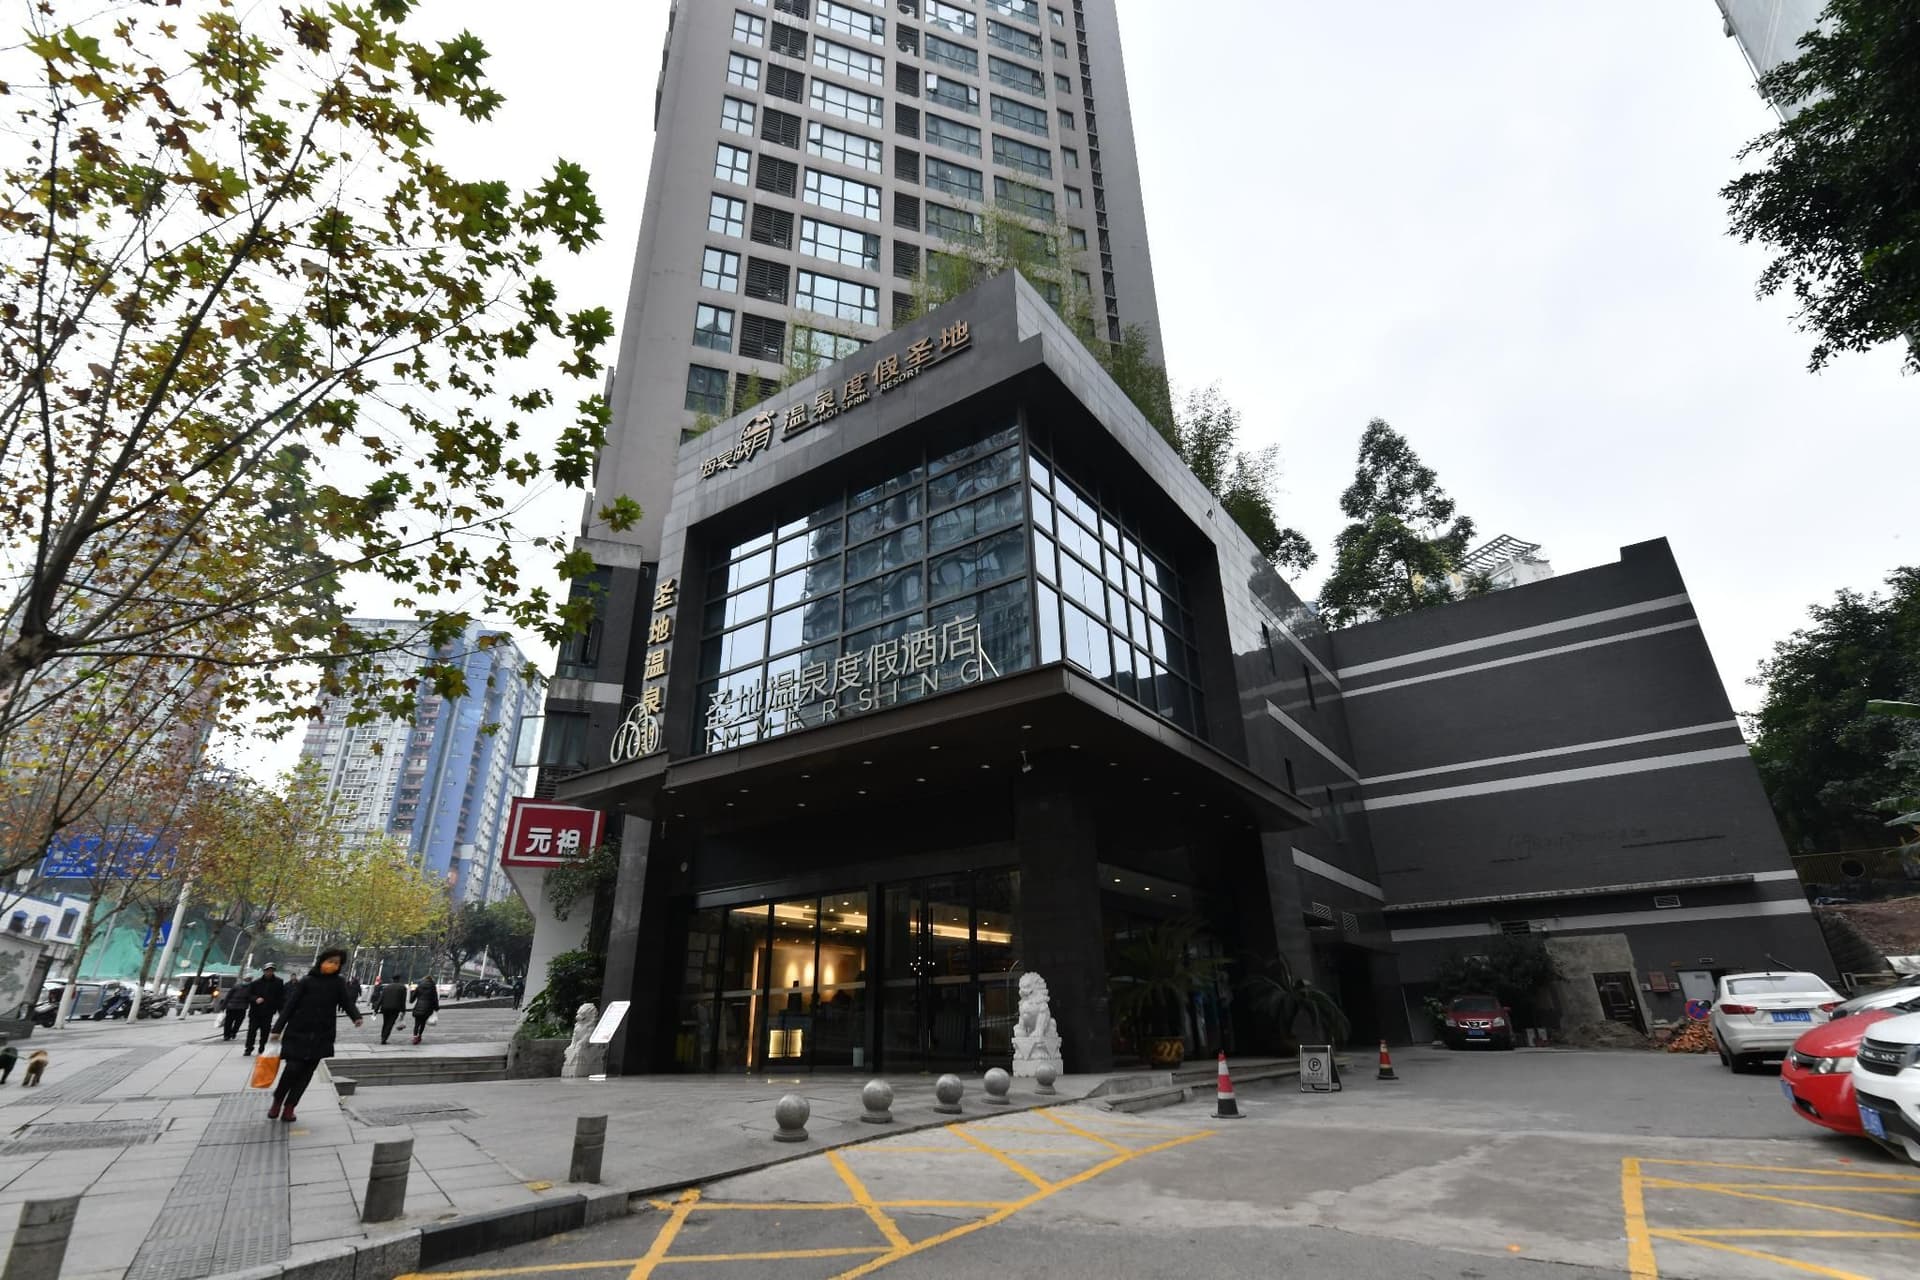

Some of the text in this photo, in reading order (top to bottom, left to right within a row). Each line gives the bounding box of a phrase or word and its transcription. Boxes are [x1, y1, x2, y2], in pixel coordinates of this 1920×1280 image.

[783, 320, 969, 433] 温泉度假圣地
[819, 406, 839, 422] HOT
[880, 366, 921, 392] RESORT
[704, 614, 978, 731] 圣地温泉度假酒店
[525, 827, 581, 855] 元祖
